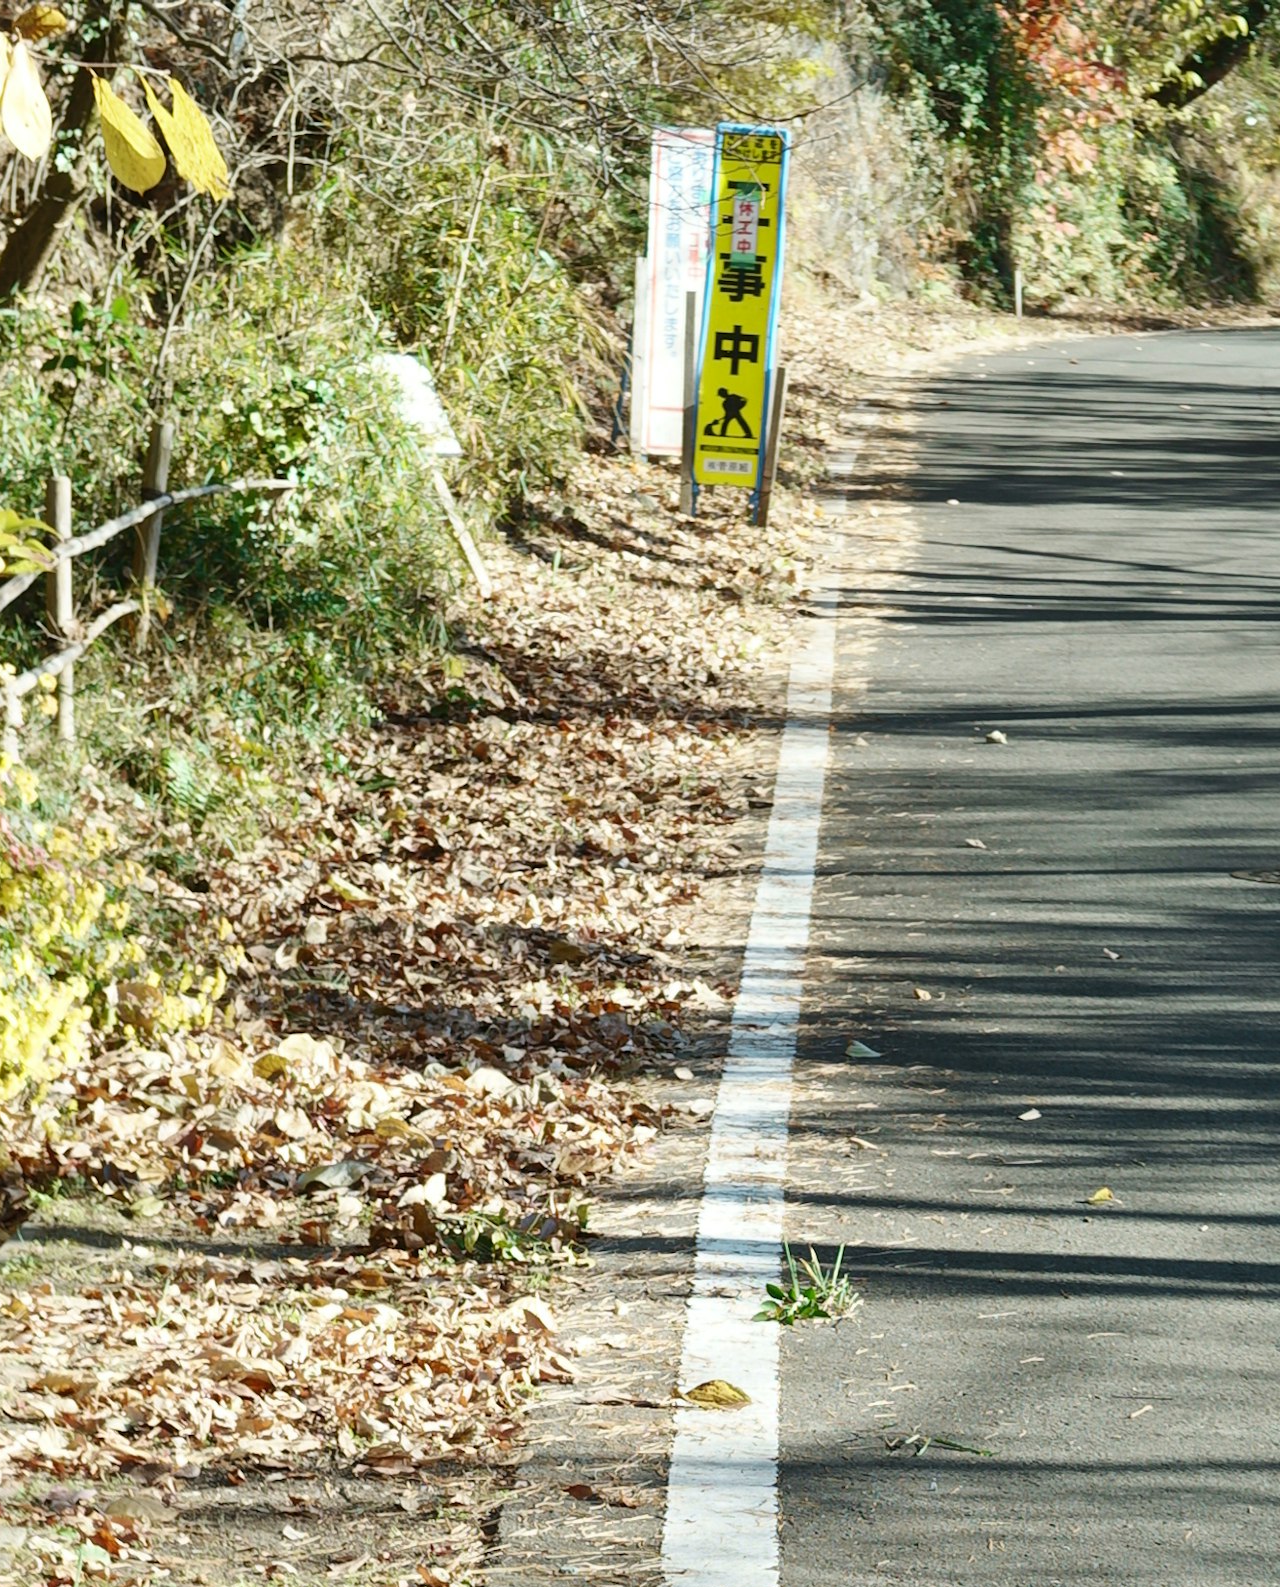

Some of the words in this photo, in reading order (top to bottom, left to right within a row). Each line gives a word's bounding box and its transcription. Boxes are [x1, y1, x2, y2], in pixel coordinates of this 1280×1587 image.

[713, 180, 771, 376] 工事中
[737, 201, 754, 254] 休工中
